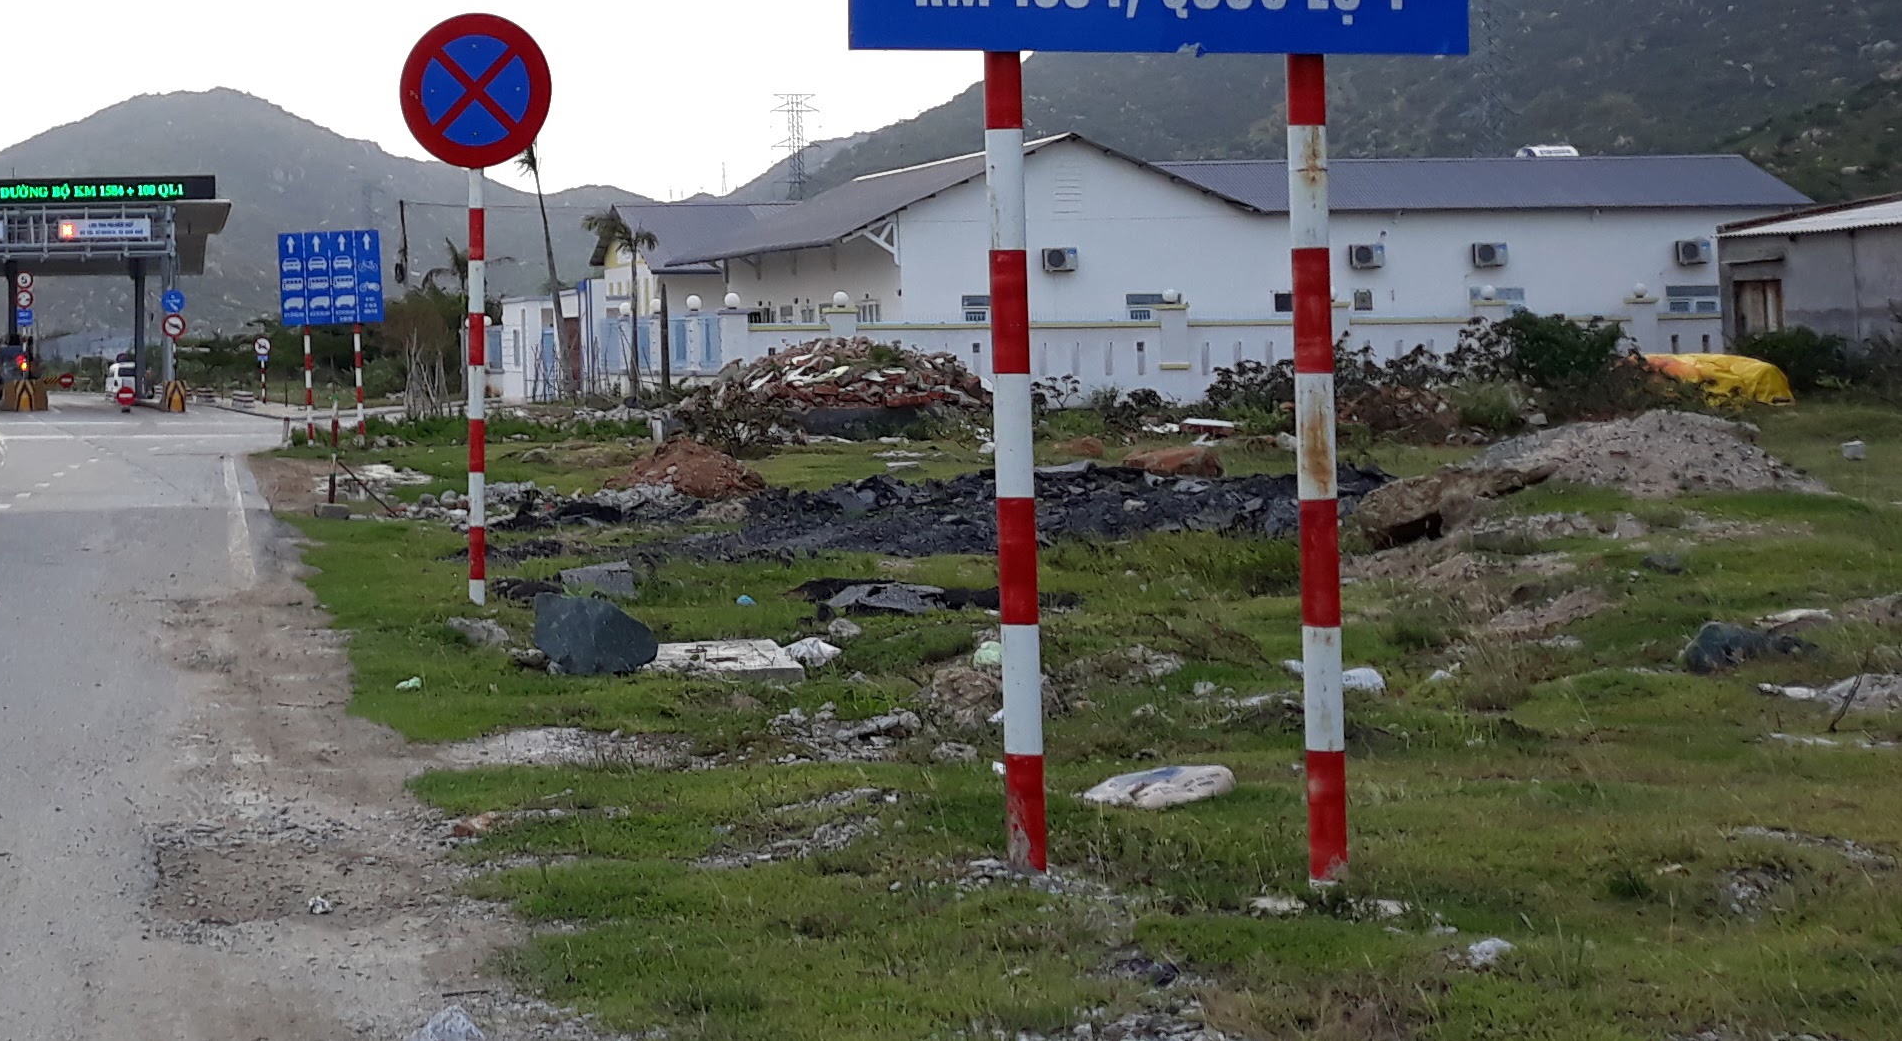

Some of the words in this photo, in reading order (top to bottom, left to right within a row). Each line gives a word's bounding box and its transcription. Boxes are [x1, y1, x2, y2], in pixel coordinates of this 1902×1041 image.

[51, 183, 71, 200] BỘ
[73, 185, 96, 197] KM
[158, 183, 184, 198] QL1
